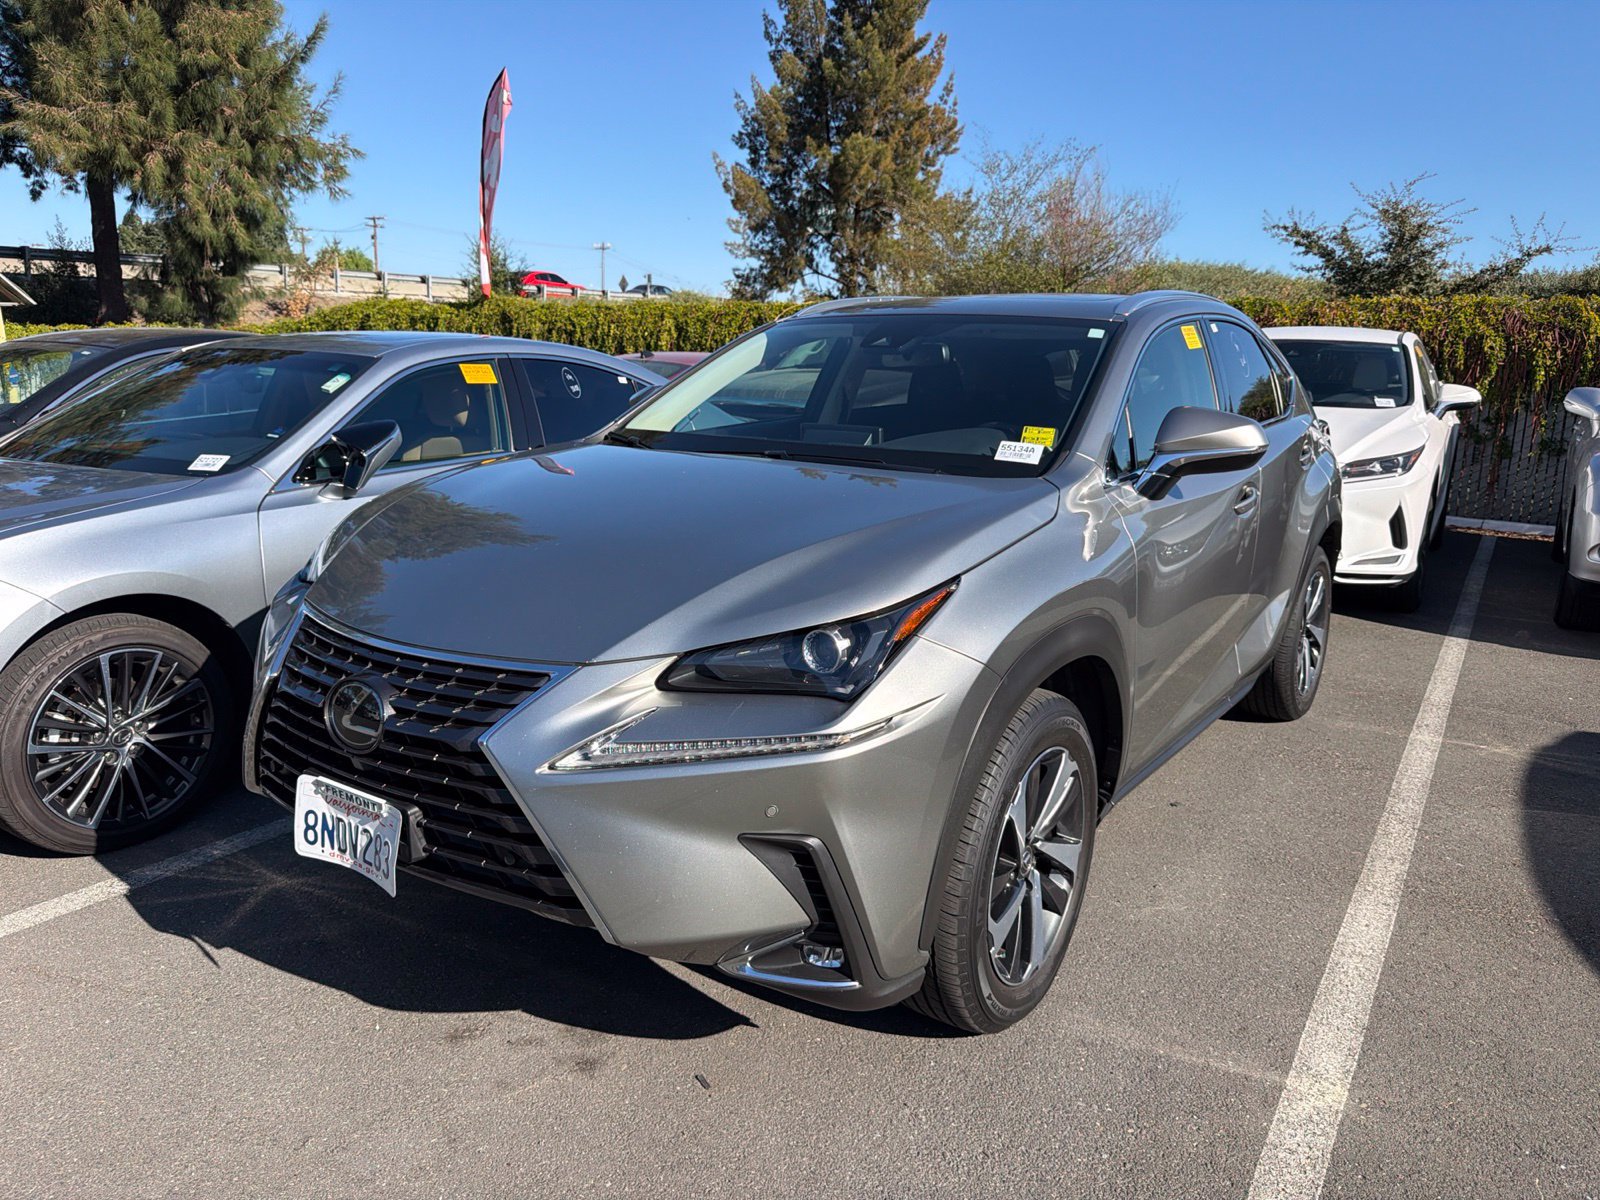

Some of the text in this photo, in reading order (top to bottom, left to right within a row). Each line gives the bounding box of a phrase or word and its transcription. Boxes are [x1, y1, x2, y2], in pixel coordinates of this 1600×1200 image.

[1001, 443, 1035, 454] 55134A
[325, 784, 378, 812] FREMONT
[303, 809, 392, 880] 8NDV283
